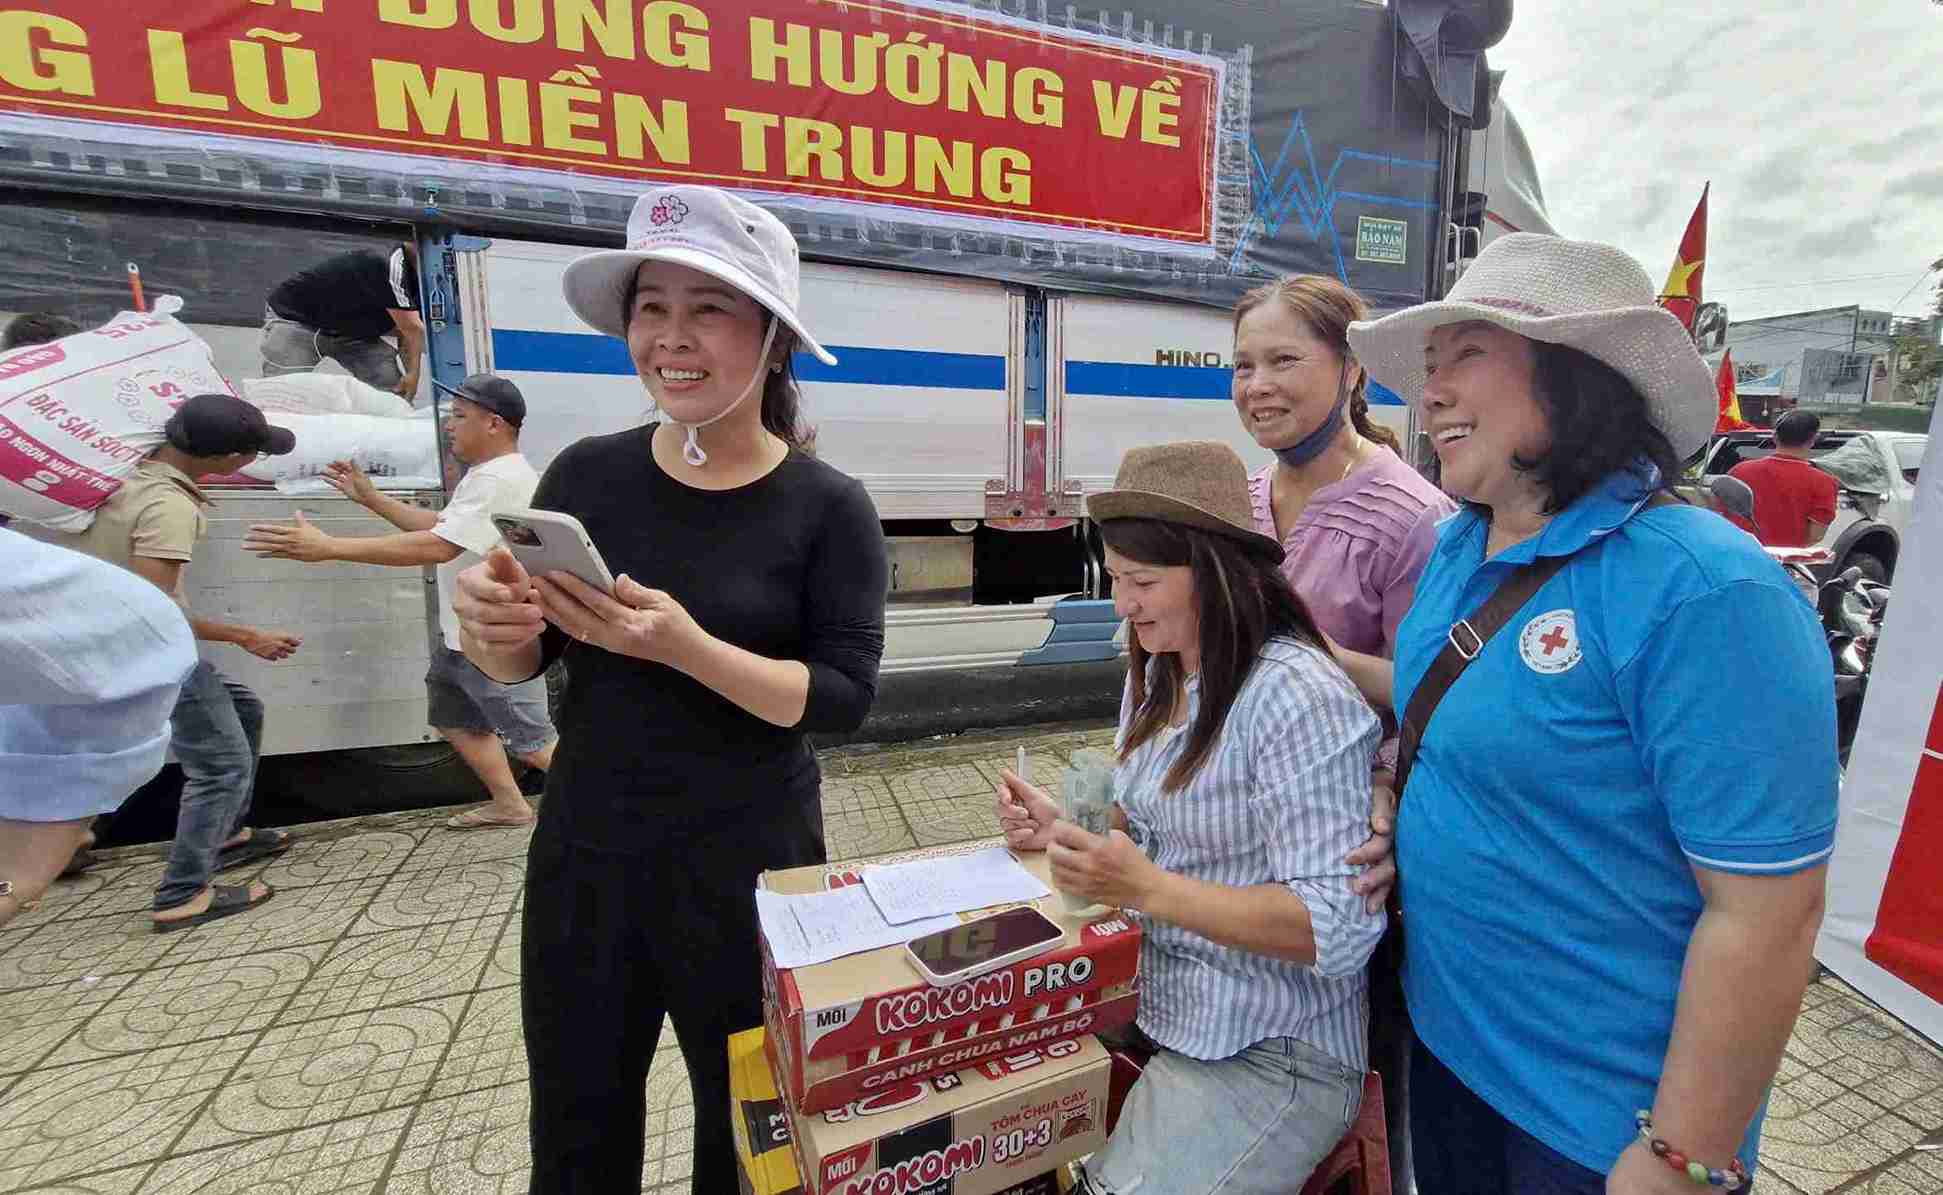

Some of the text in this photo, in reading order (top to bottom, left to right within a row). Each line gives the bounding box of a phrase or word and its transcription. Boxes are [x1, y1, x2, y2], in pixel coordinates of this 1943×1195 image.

[148, 27, 321, 119] LŨ
[371, 62, 690, 165] MIỀN
[725, 107, 1033, 206] TRUNG
[749, 19, 1065, 129] HƯỚNG
[1092, 76, 1183, 148] VỀ
[875, 955, 1094, 1034] KOKOMI PRO
[863, 1058, 932, 1088] CANH
[938, 1041, 1003, 1066] CHUA
[1008, 1024, 1059, 1049] NAM
[845, 1135, 985, 1195] KOKOMI
[992, 1119, 1052, 1164] 30+3
